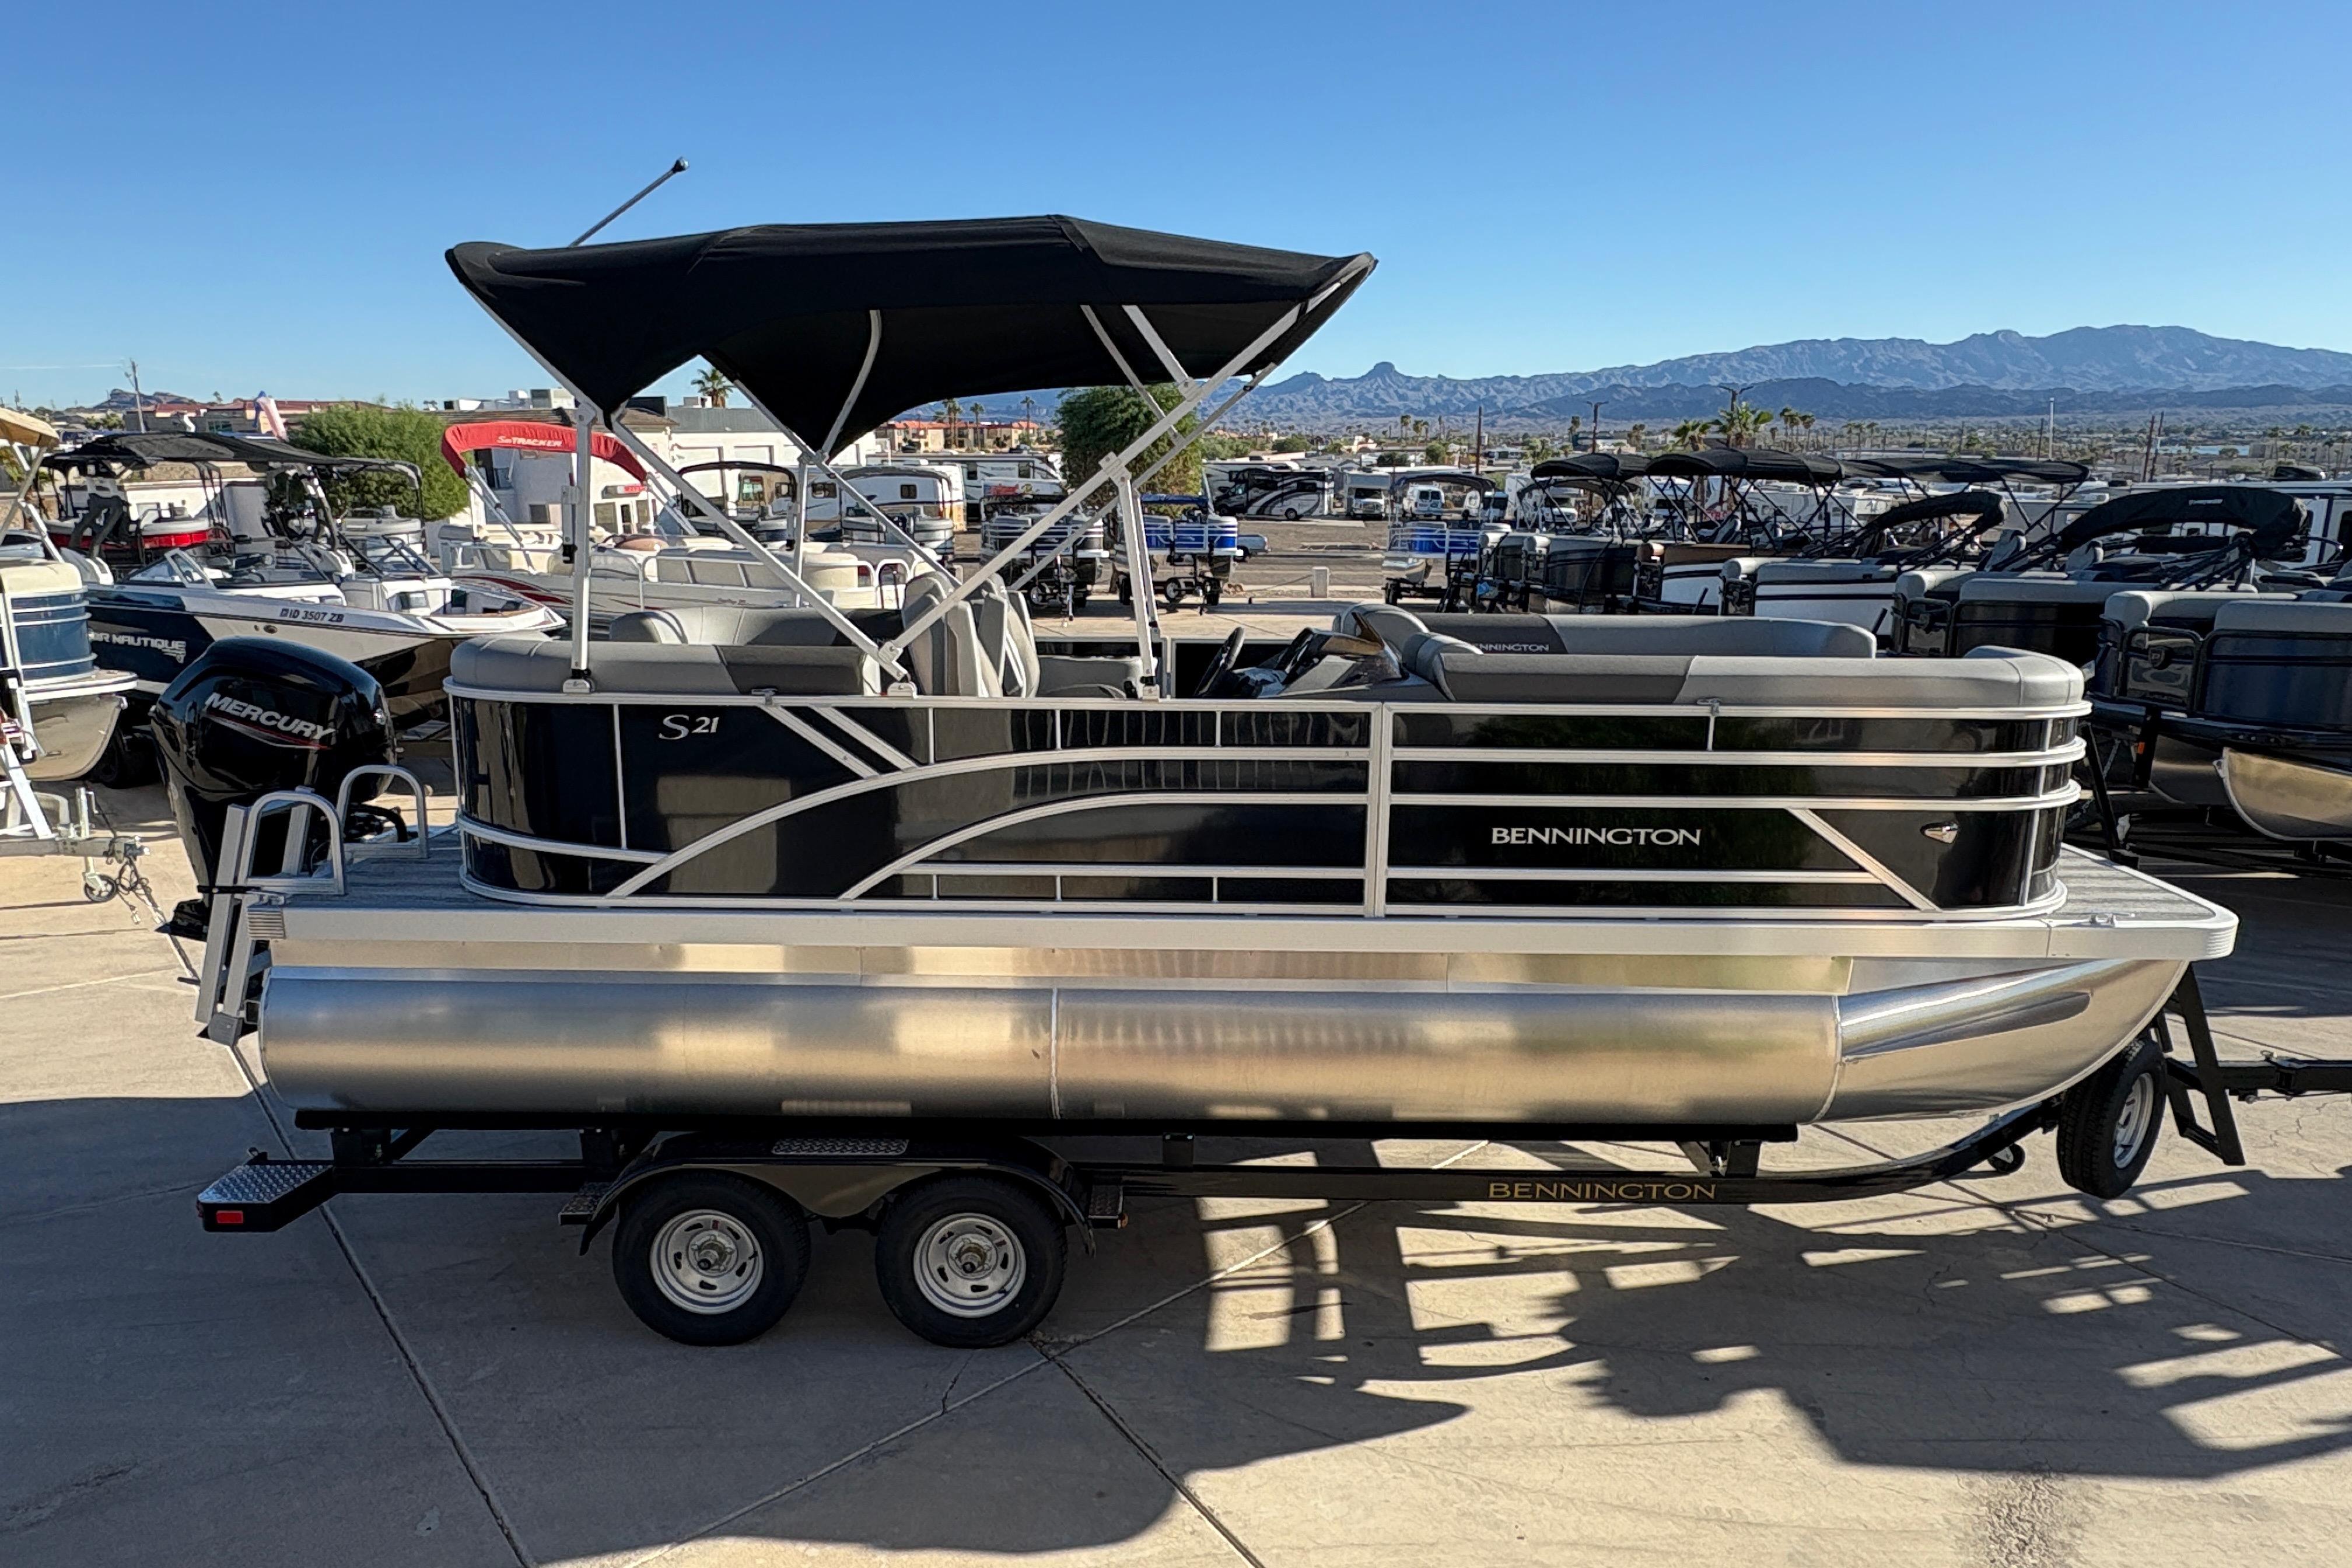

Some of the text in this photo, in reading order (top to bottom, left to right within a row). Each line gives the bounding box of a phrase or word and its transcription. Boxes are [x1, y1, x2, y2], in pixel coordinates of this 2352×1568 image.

[301, 610, 327, 621] 3507
[112, 634, 186, 650] NAUTIQUE
[1474, 643, 1550, 652] NNINGTON
[204, 692, 336, 740] MERCURY
[1490, 827, 1702, 846] BENNINGTON
[1488, 1182, 1717, 1200] BENNINGTON
